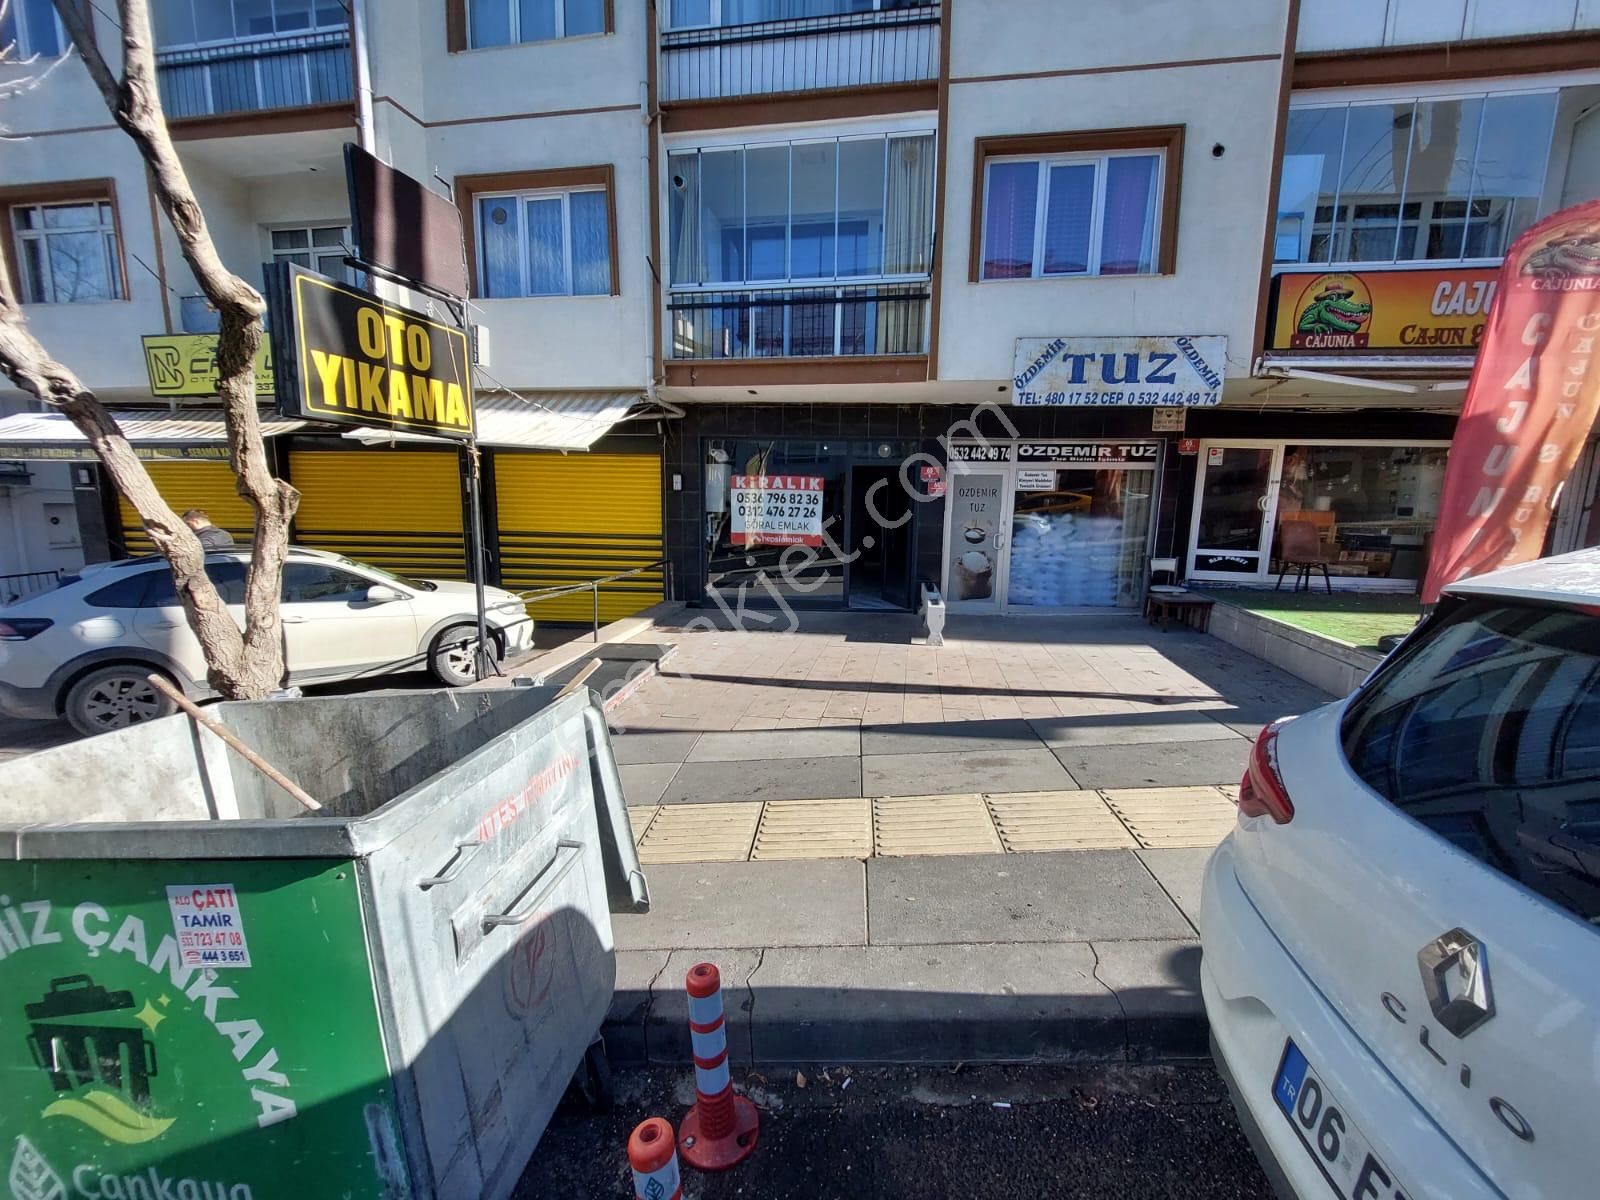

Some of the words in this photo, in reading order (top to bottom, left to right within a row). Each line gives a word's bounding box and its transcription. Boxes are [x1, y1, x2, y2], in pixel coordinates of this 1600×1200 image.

[356, 307, 431, 370] OTO
[1305, 335, 1356, 347] CAJUNIA
[1399, 324, 1466, 346] CAJUN
[1014, 338, 1067, 390] ÖZDEMİR
[1062, 352, 1177, 384] TUZ
[1176, 336, 1221, 390] ÖZDEMİR
[310, 349, 470, 426] YIKAMA
[1018, 392, 1042, 405] TEL:
[1045, 392, 1065, 405] 480
[1069, 392, 1081, 405] 17
[1084, 392, 1098, 405] 52
[1101, 392, 1123, 405] CEP
[1127, 393, 1135, 405] 0
[1138, 392, 1158, 405] 532
[1161, 393, 1184, 405] 442
[1186, 393, 1200, 405] 49
[1203, 393, 1217, 405] 74
[950, 446, 969, 460] 0532
[970, 447, 986, 460] 442
[988, 446, 999, 460] 49
[1000, 447, 1011, 460] 74
[1019, 444, 1111, 457] ÖZDEMİR
[1118, 446, 1158, 457] TUZ
[735, 476, 820, 490] KİRALIK
[736, 493, 763, 504] 0536
[767, 493, 787, 504] 796
[789, 493, 803, 505] 82
[805, 494, 819, 505] 36
[766, 506, 785, 517] 476
[788, 507, 801, 517] 27
[803, 507, 817, 518] 26
[970, 503, 986, 512] TUZ
[777, 521, 810, 531] EMLAK
[191, 889, 234, 911] ÇATI
[180, 911, 233, 927] TAMİR
[194, 932, 213, 946] 723
[215, 932, 226, 946] 47
[230, 931, 242, 946] 08
[202, 951, 219, 961] 444
[220, 951, 227, 961] 3
[228, 950, 245, 961] 651
[72, 901, 298, 1128] ÇANKAYA
[1381, 991, 1536, 1143] CLIO
[1282, 1075, 1296, 1101] TR
[1298, 1077, 1345, 1162] 06
